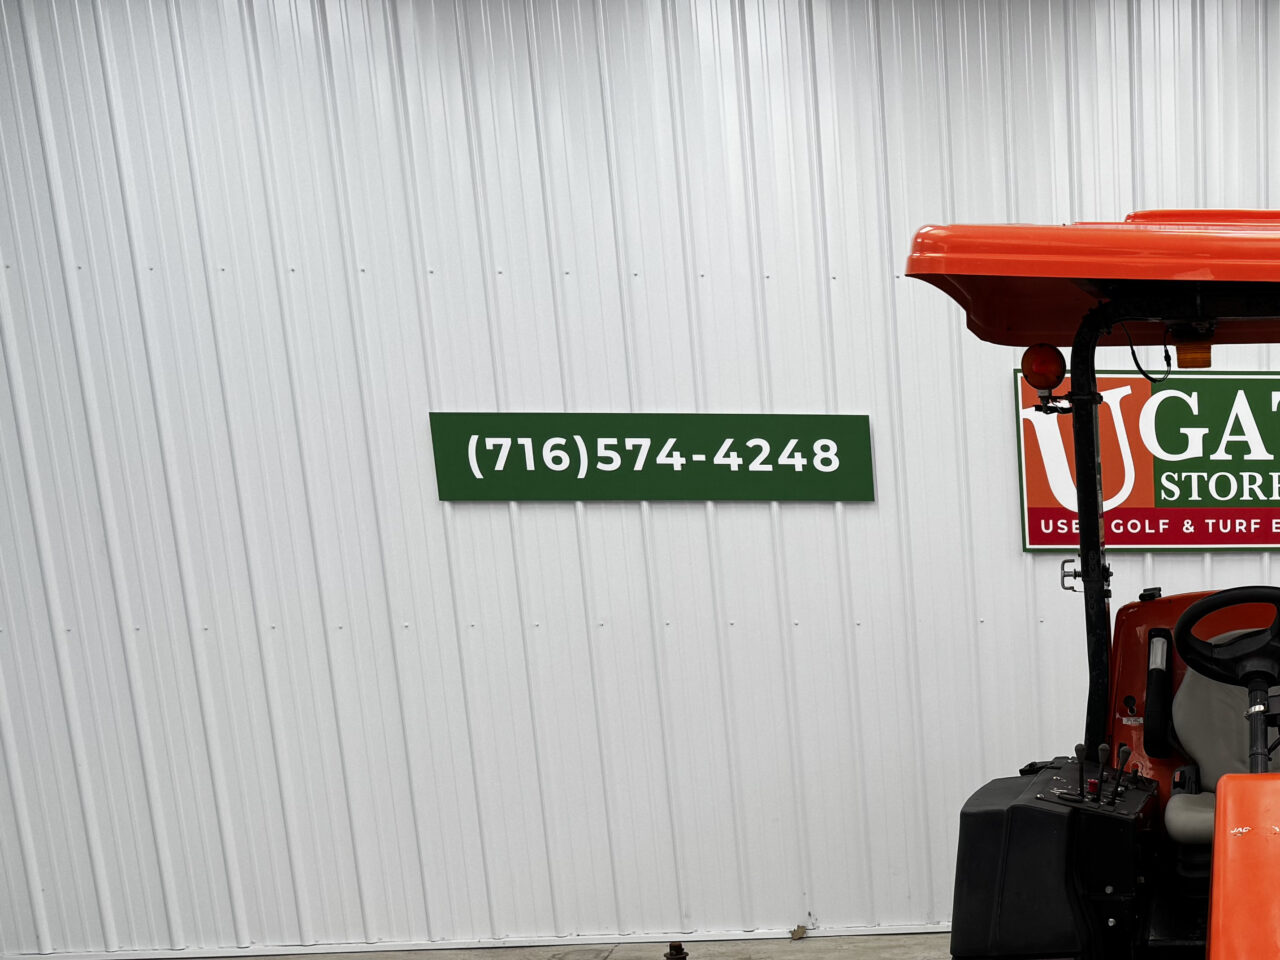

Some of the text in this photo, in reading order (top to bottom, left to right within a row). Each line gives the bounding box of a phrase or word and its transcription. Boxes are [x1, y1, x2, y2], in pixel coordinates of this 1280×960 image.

[468, 435, 839, 478] (716)574-4248
[1041, 520, 1079, 533] USE
[1111, 520, 1169, 533] GOLF
[1183, 520, 1194, 533] &
[1205, 520, 1260, 532] TURF
